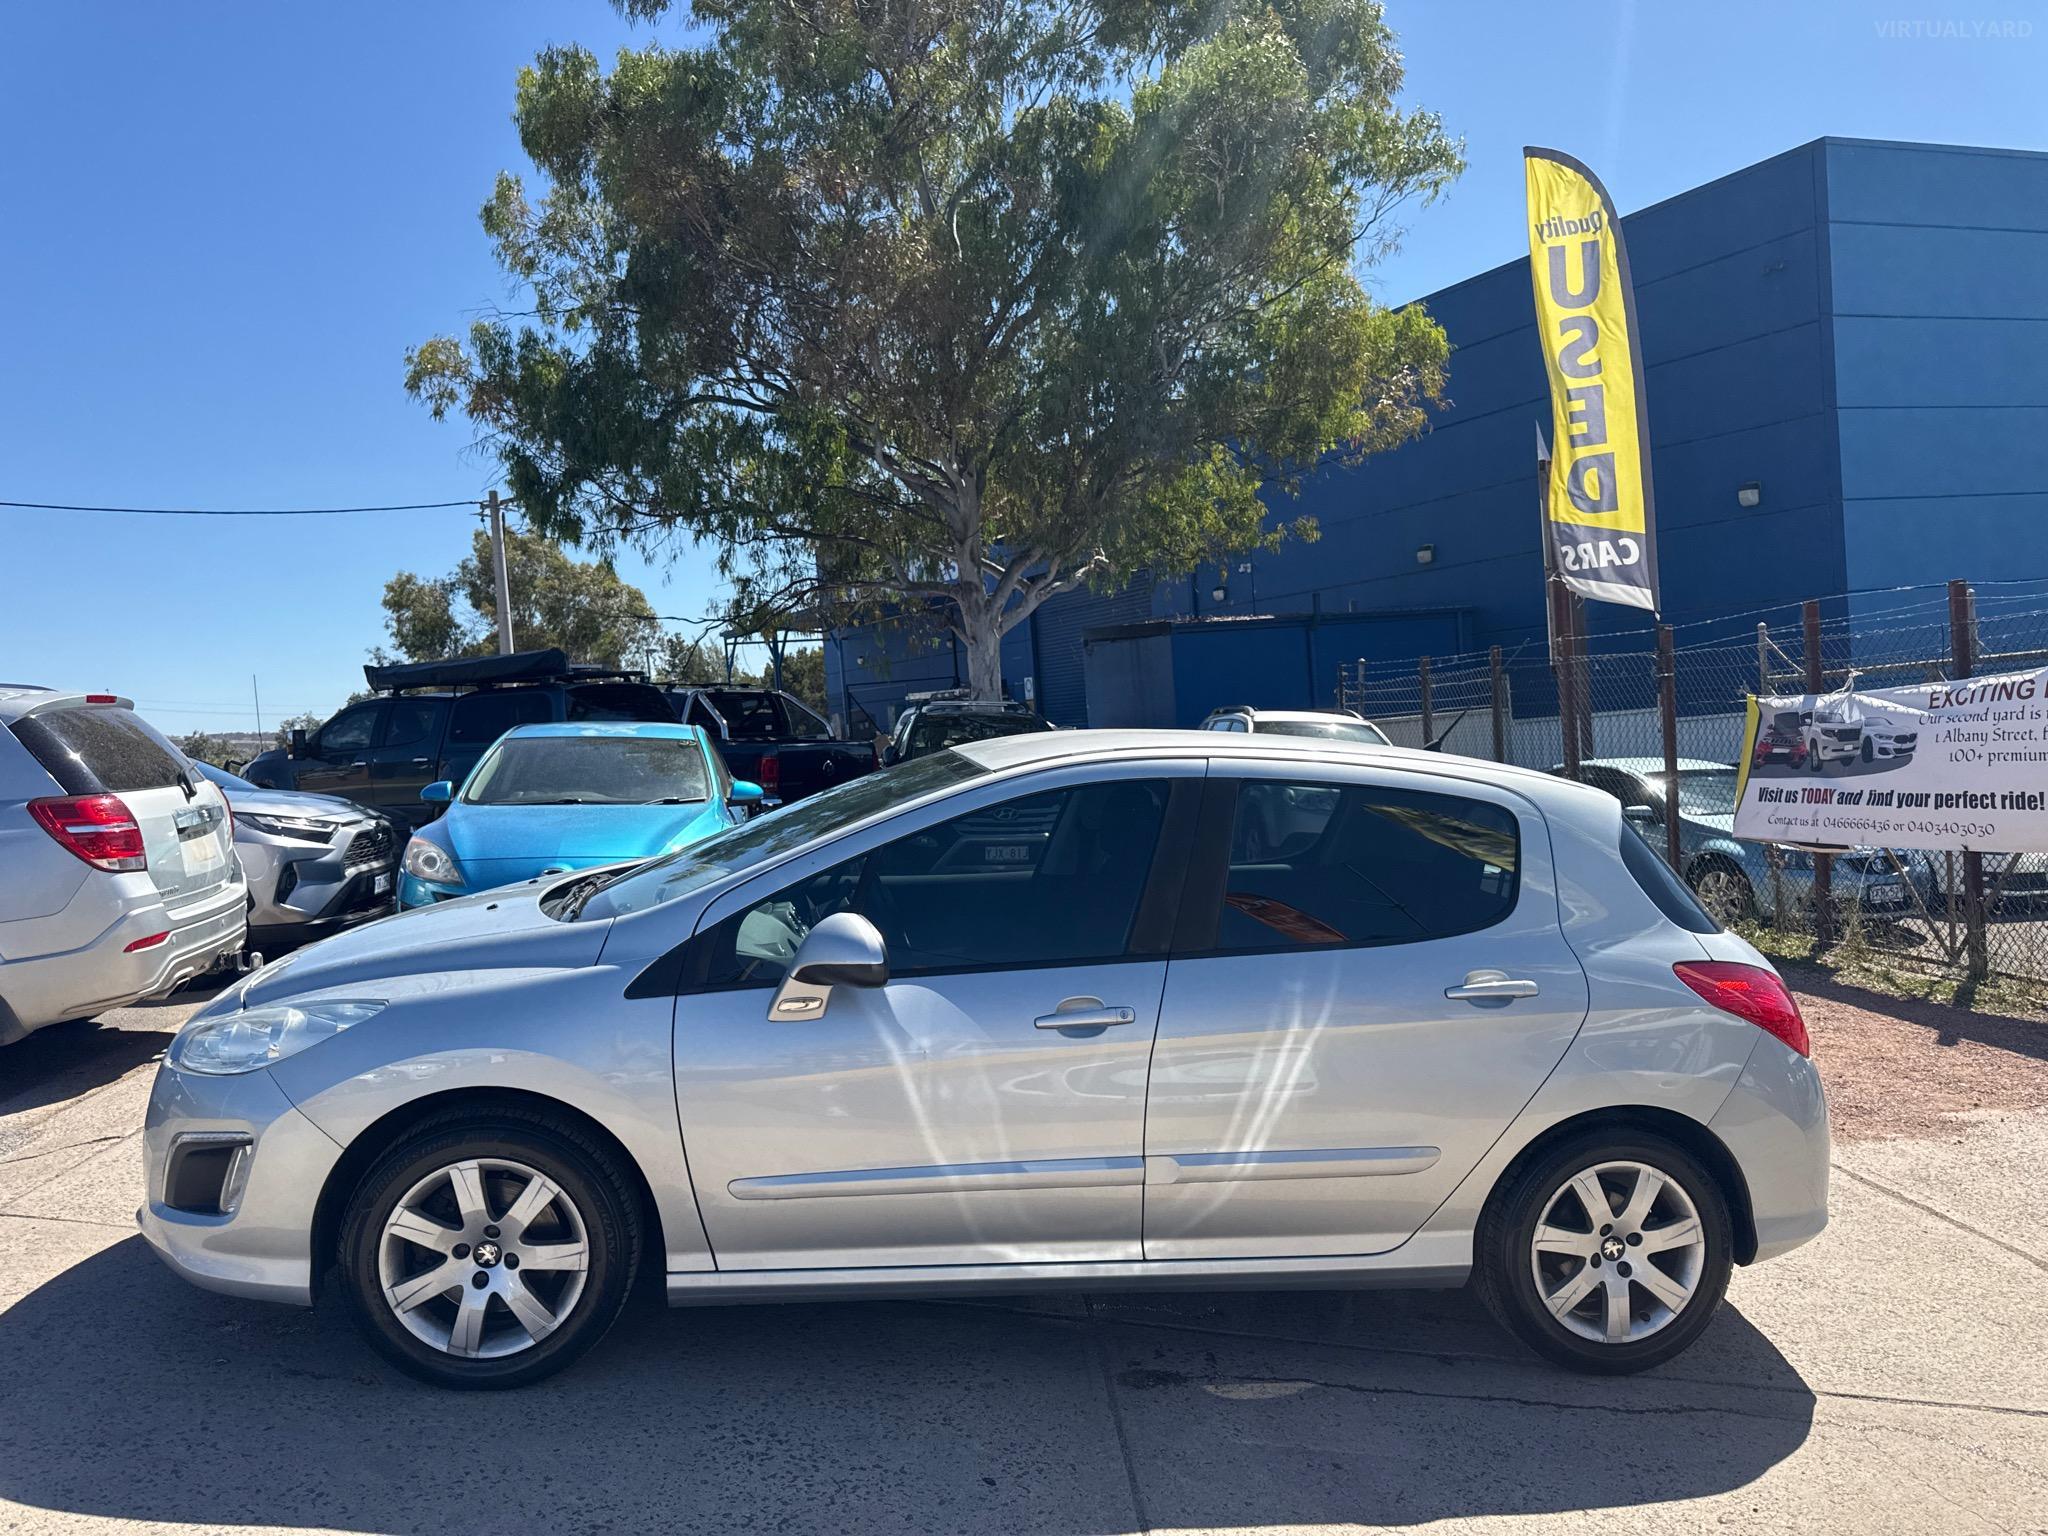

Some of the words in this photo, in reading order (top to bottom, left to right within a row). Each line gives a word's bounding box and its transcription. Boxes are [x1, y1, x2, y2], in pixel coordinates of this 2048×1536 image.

[1928, 680, 2036, 709] EXCITING
[1919, 712, 1944, 725] Our
[1946, 707, 1989, 723] second
[1993, 705, 2025, 726] yard
[2030, 705, 2041, 720] is
[1943, 728, 1988, 747] Albany
[1950, 748, 1983, 762] 100+
[1758, 787, 1784, 803] Visit
[1785, 789, 1799, 803] us
[1800, 788, 1836, 804] TODAY
[1837, 790, 1864, 805] and
[1866, 790, 1895, 806] find
[1896, 791, 1931, 809] your
[1934, 790, 1998, 810] perfect
[2001, 791, 2045, 811] ride!
[1767, 814, 1798, 826] Contact
[1800, 818, 1809, 826] us
[1811, 818, 1819, 827] at
[1823, 817, 1891, 833] 0466666436
[1893, 823, 1905, 832] or
[1908, 820, 1995, 837] 0403403030
